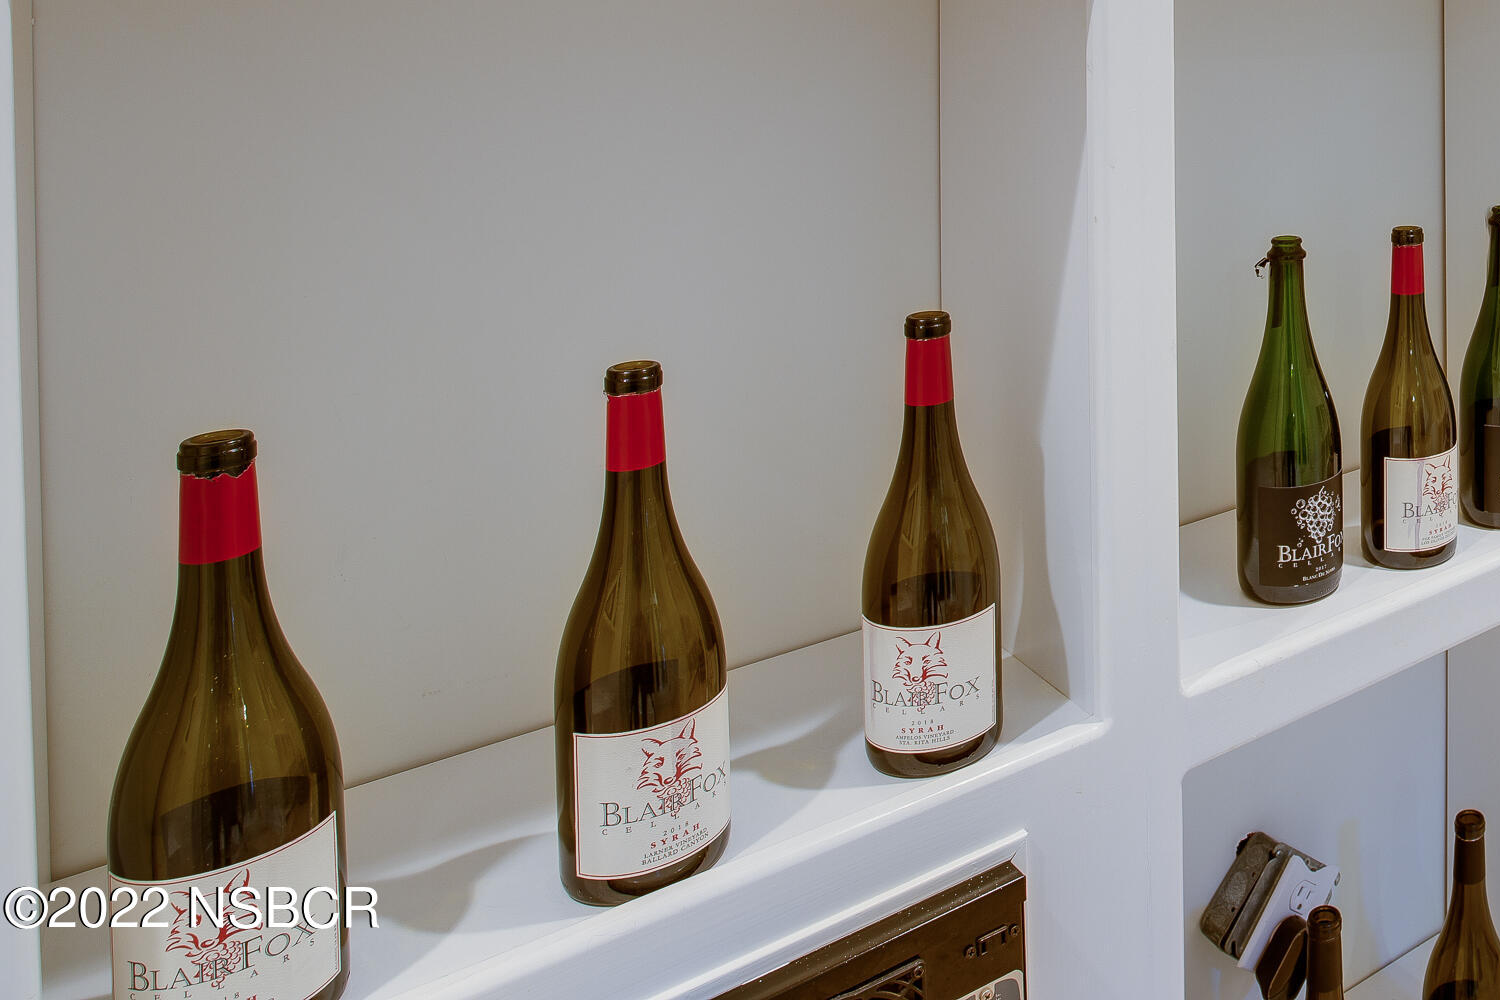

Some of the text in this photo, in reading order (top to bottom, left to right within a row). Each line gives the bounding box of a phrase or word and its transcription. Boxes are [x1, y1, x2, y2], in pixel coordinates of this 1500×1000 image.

[1277, 543, 1328, 563] BLAIR
[932, 675, 980, 705] FOX
[901, 724, 945, 734] SYRAH
[685, 762, 727, 807] FOX
[650, 822, 700, 850] SYRAH
